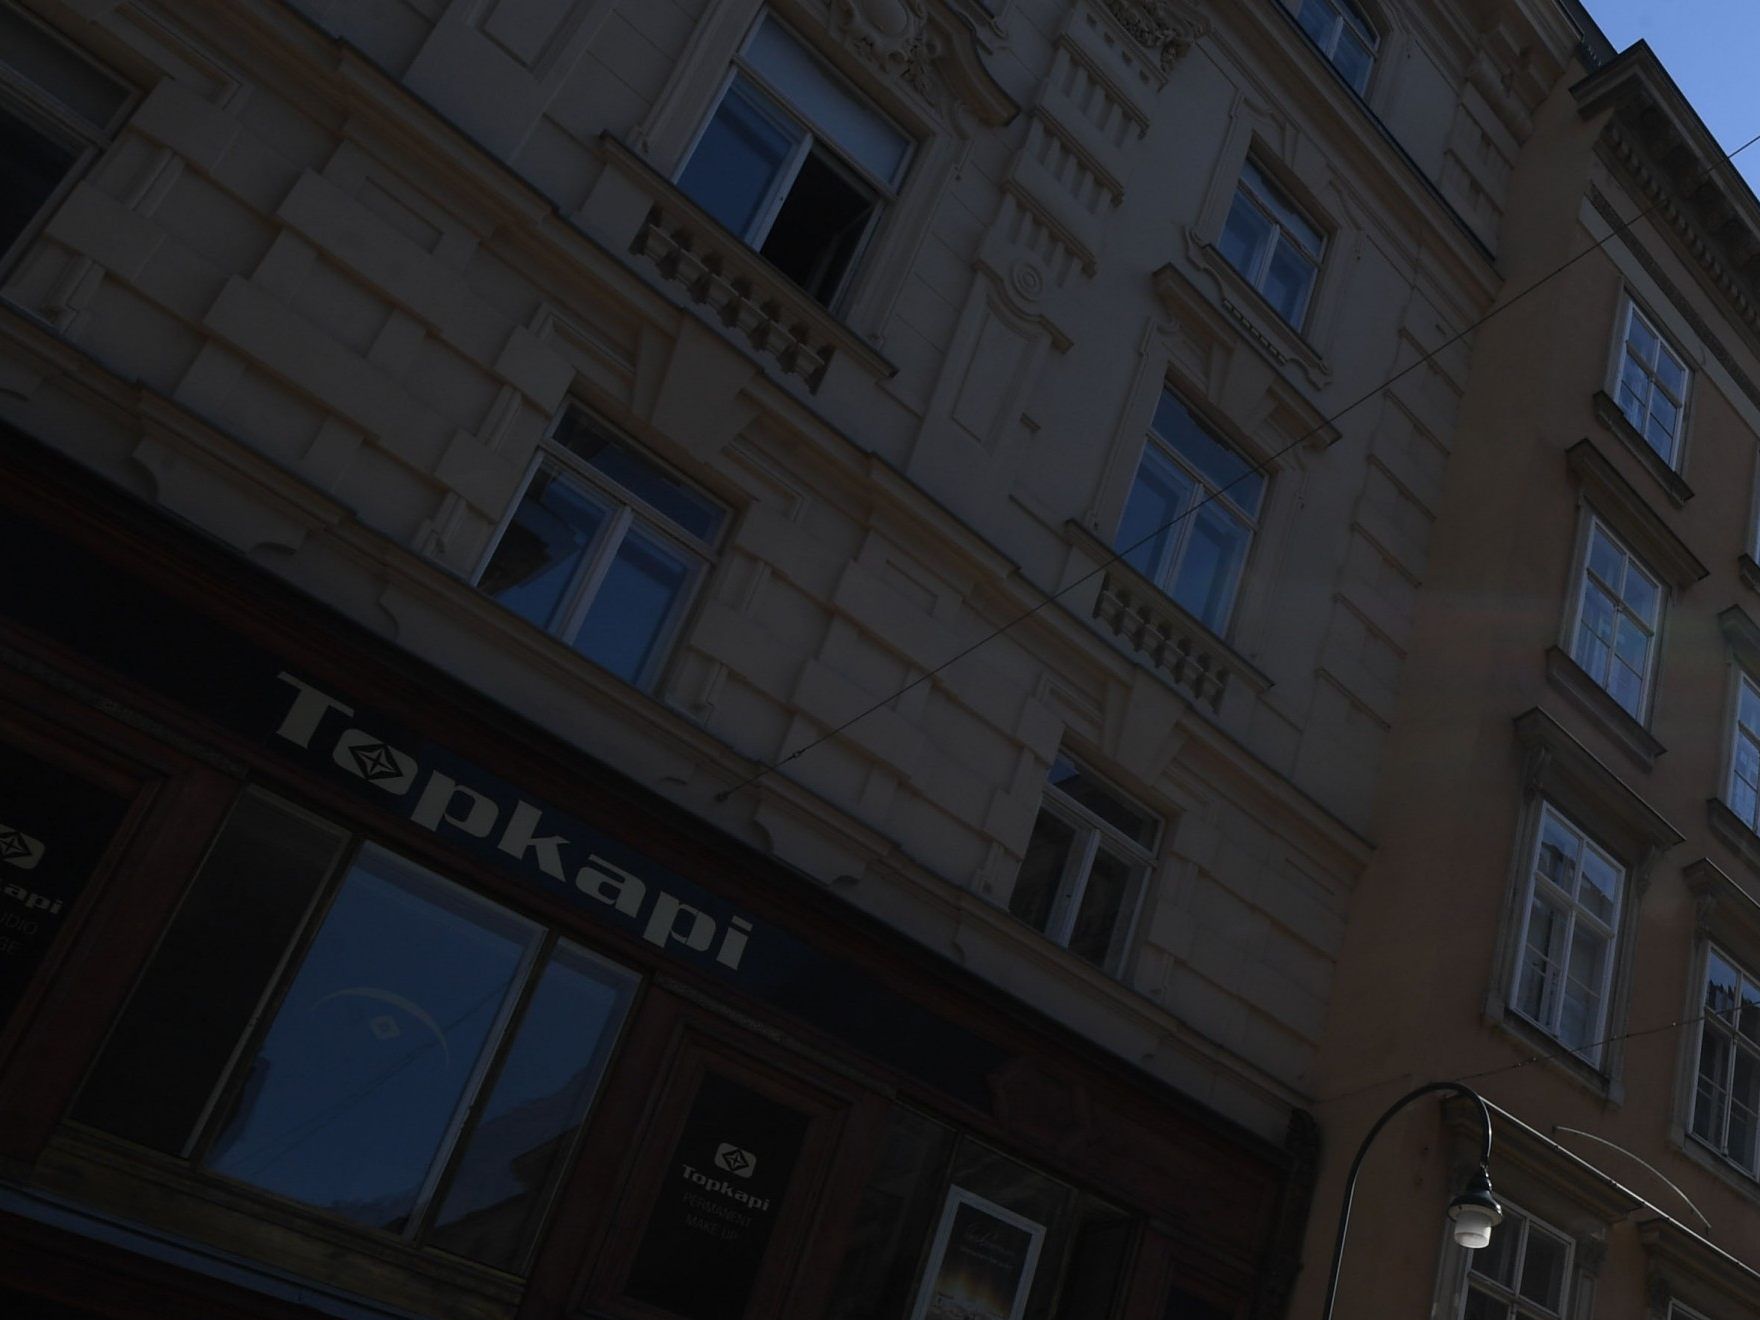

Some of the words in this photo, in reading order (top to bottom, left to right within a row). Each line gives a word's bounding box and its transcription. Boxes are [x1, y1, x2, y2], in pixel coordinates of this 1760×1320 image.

[273, 670, 755, 971] Topkapi
[681, 1192, 752, 1227] PERMANENT
[682, 1164, 770, 1211] Topkapi
